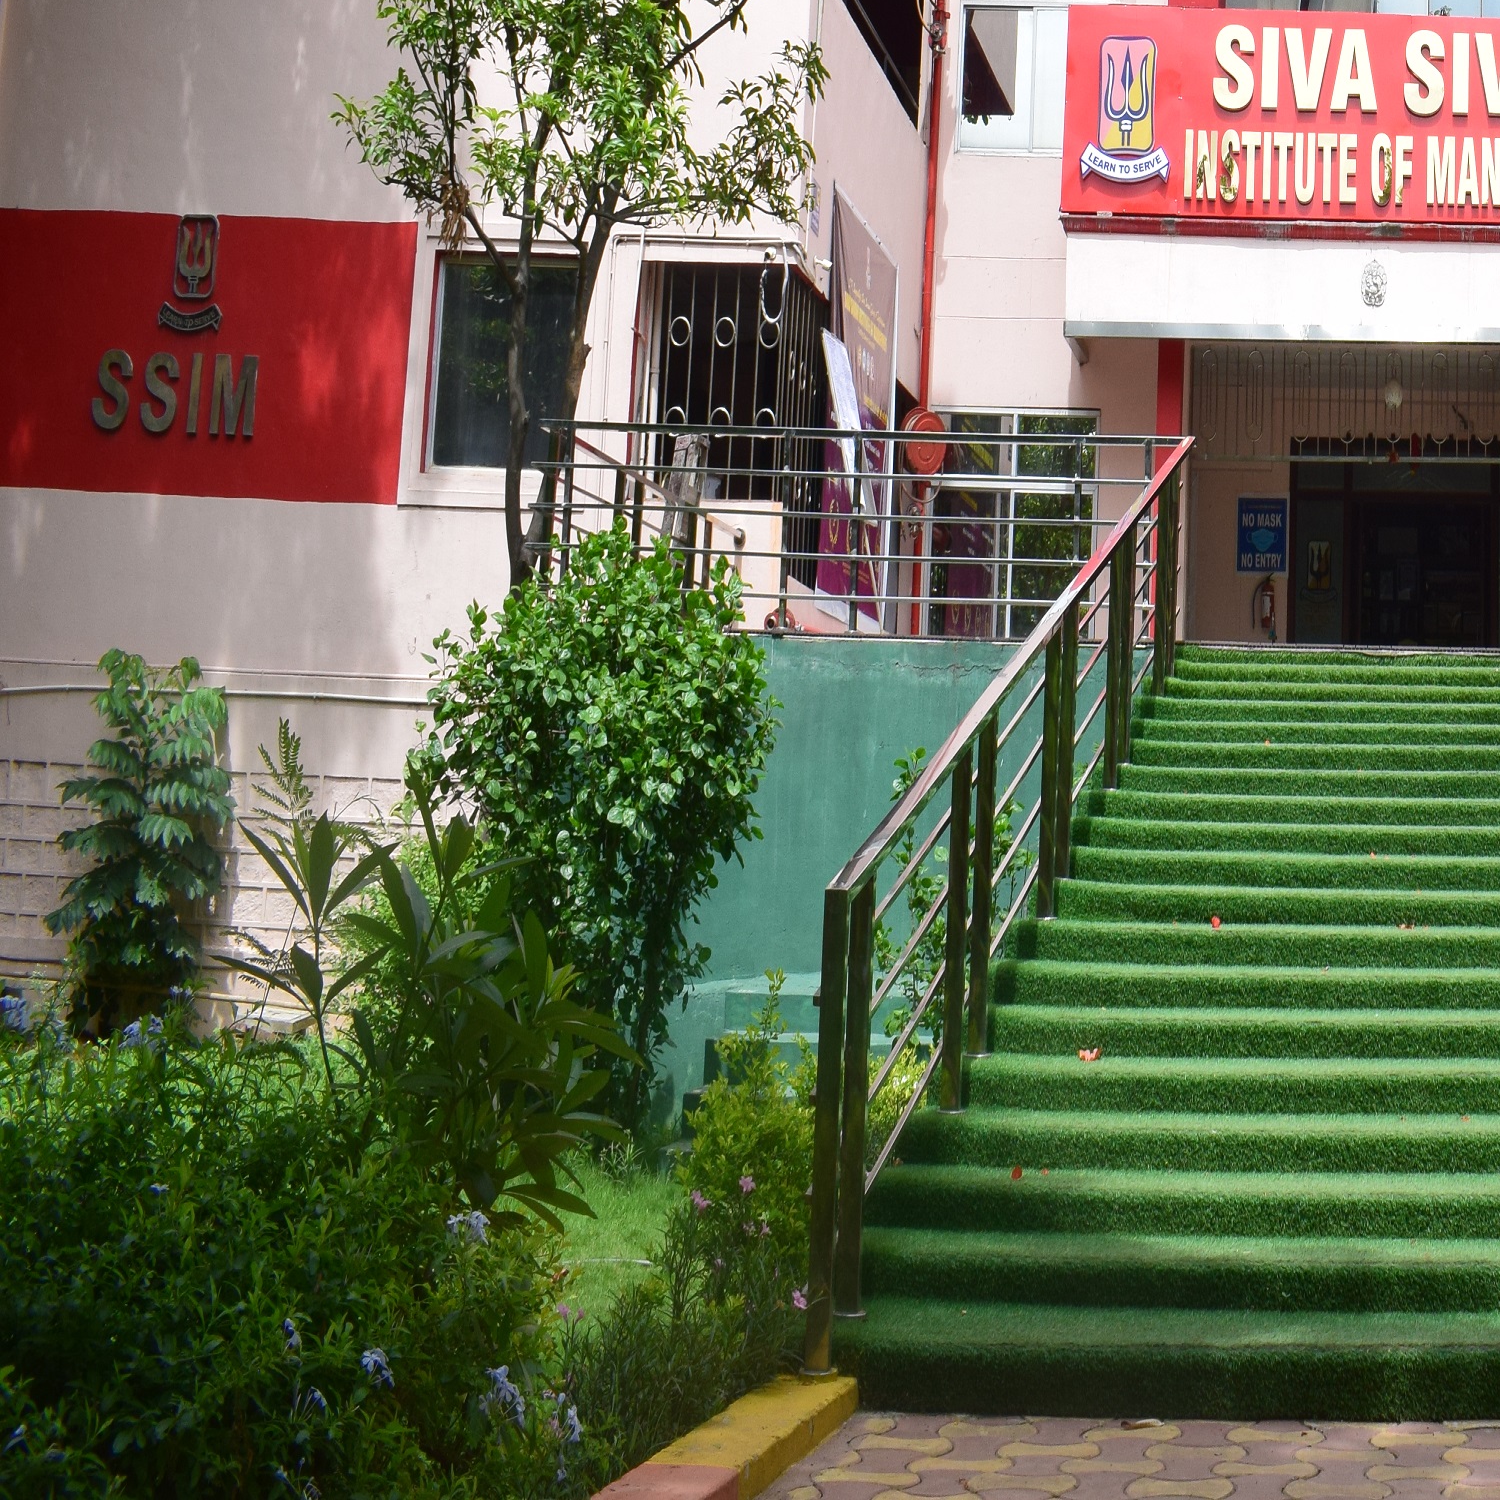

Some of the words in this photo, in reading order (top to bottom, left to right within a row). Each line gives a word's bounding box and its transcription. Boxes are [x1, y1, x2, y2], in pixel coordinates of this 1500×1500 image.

[1213, 24, 1378, 113] SIVA
[1088, 152, 1116, 173] LEARN
[1119, 164, 1131, 174] TO
[1133, 154, 1162, 173] SERVE
[1184, 129, 1356, 204] INSTITUTE
[1371, 132, 1413, 207] OF
[91, 349, 259, 437] SSIM
[1242, 513, 1255, 527] NO
[1257, 513, 1282, 528] MASK
[1241, 553, 1253, 568] NO
[1255, 553, 1282, 568] ENTRY
